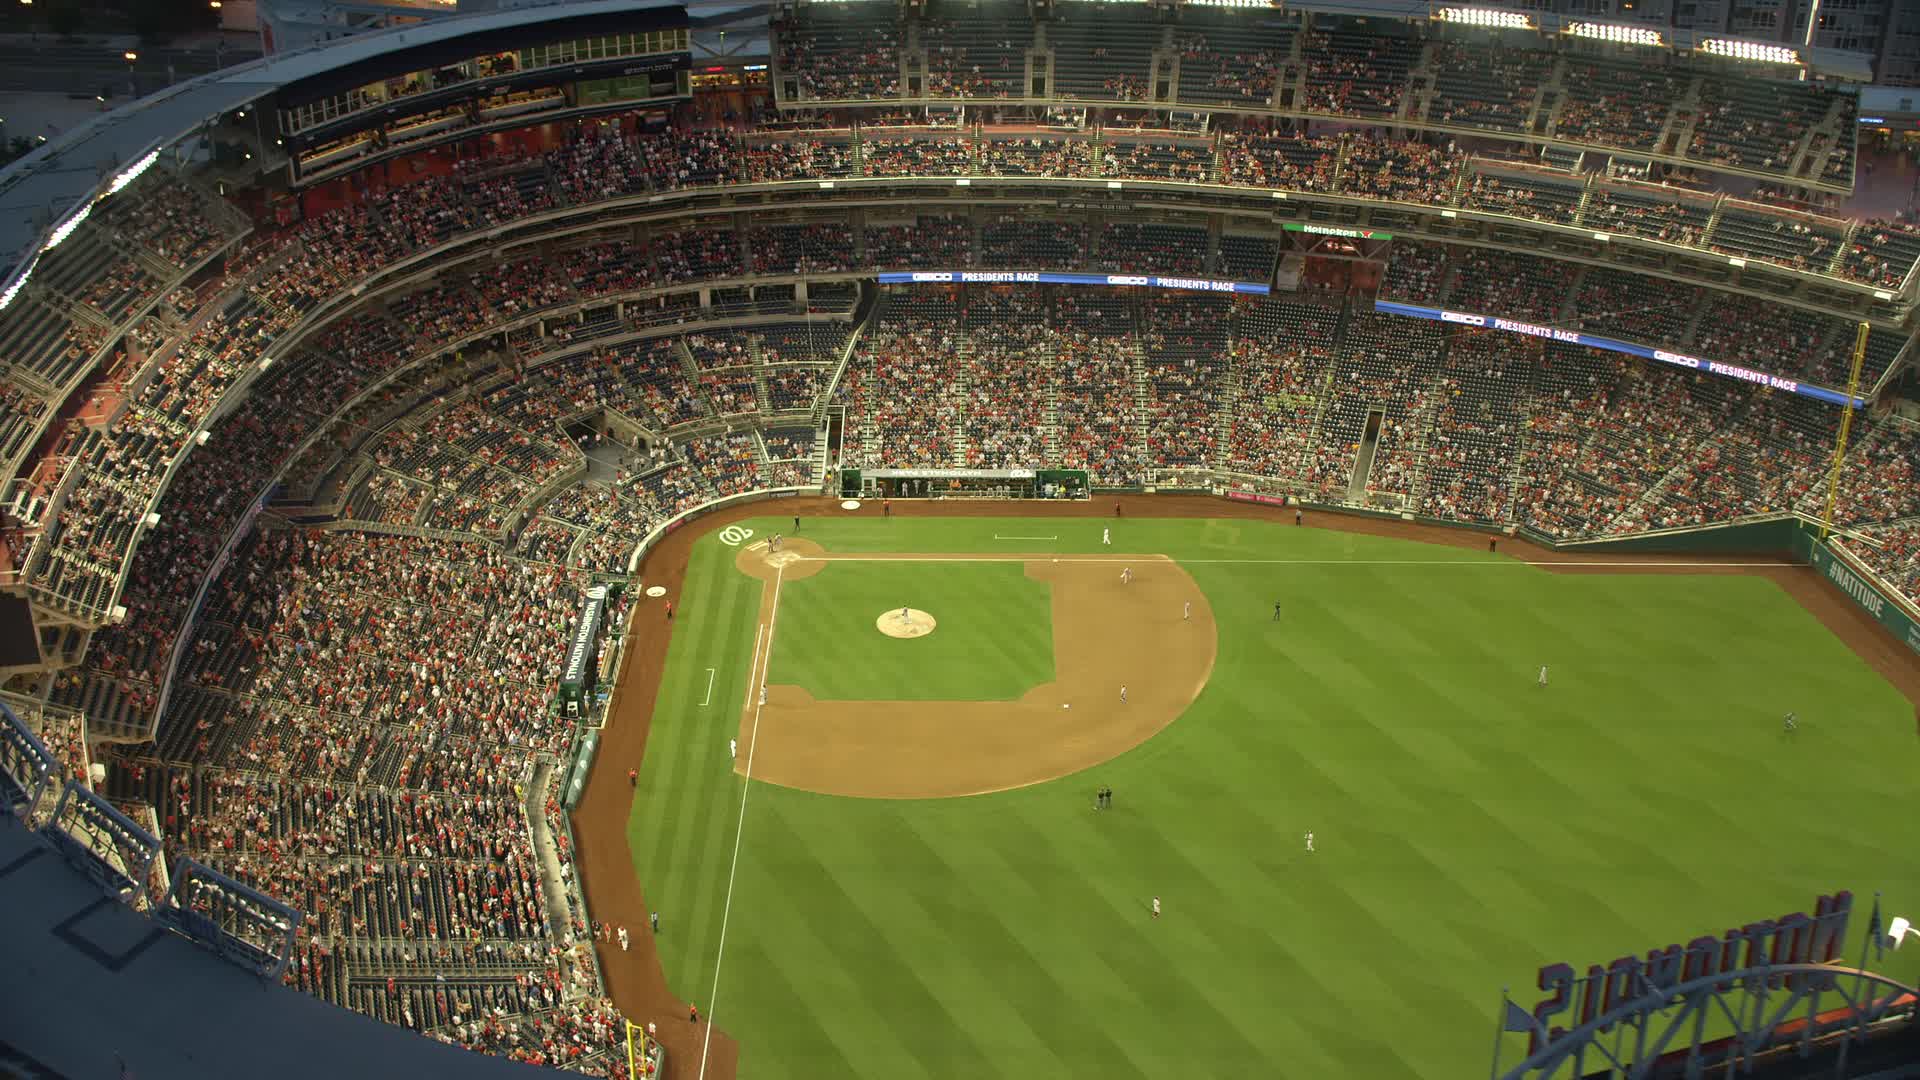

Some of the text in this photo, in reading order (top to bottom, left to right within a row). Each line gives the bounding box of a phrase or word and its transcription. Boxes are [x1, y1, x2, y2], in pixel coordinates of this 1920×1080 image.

[1303, 225, 1357, 238] Heineken
[912, 272, 1040, 282] GEICO PRESIDENTS RACE
[1107, 275, 1235, 292] GEICO PRESIDENTS RACE
[1440, 311, 1579, 343] GEICO PRESIDENTS RACE
[1653, 350, 1797, 392] GEICO PRESIDENTS RACE
[1829, 561, 1884, 618] #NATITUDE
[577, 601, 598, 642] WASHINGTON
[566, 643, 585, 680] NATIONALS
